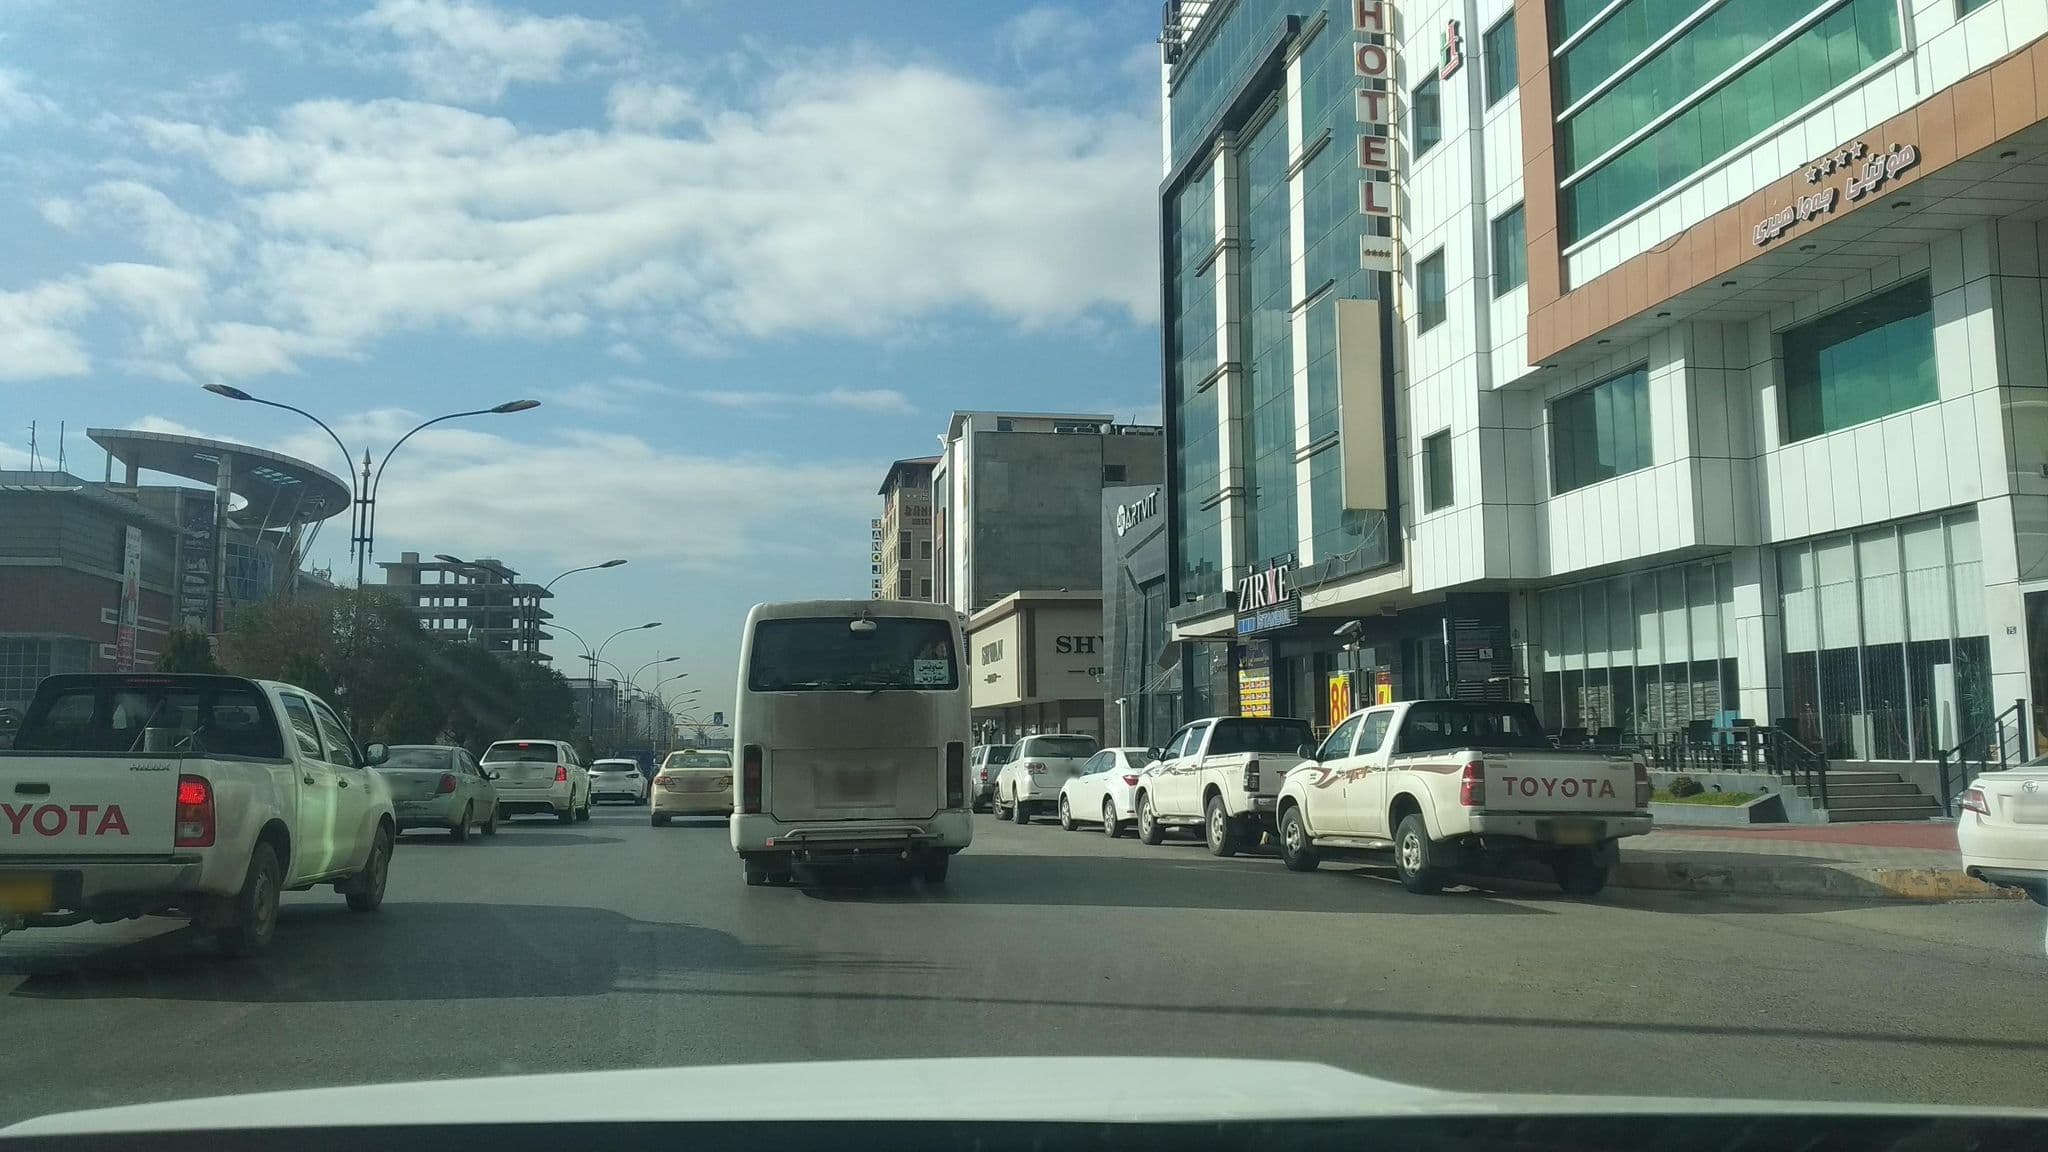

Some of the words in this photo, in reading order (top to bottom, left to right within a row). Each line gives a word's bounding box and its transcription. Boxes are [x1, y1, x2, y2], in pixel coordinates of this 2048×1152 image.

[1357, 0, 1388, 212] HOTEL
[1055, 635, 1104, 654] SH
[1502, 776, 1616, 798] TOYOTA
[0, 803, 130, 836] YOTA
